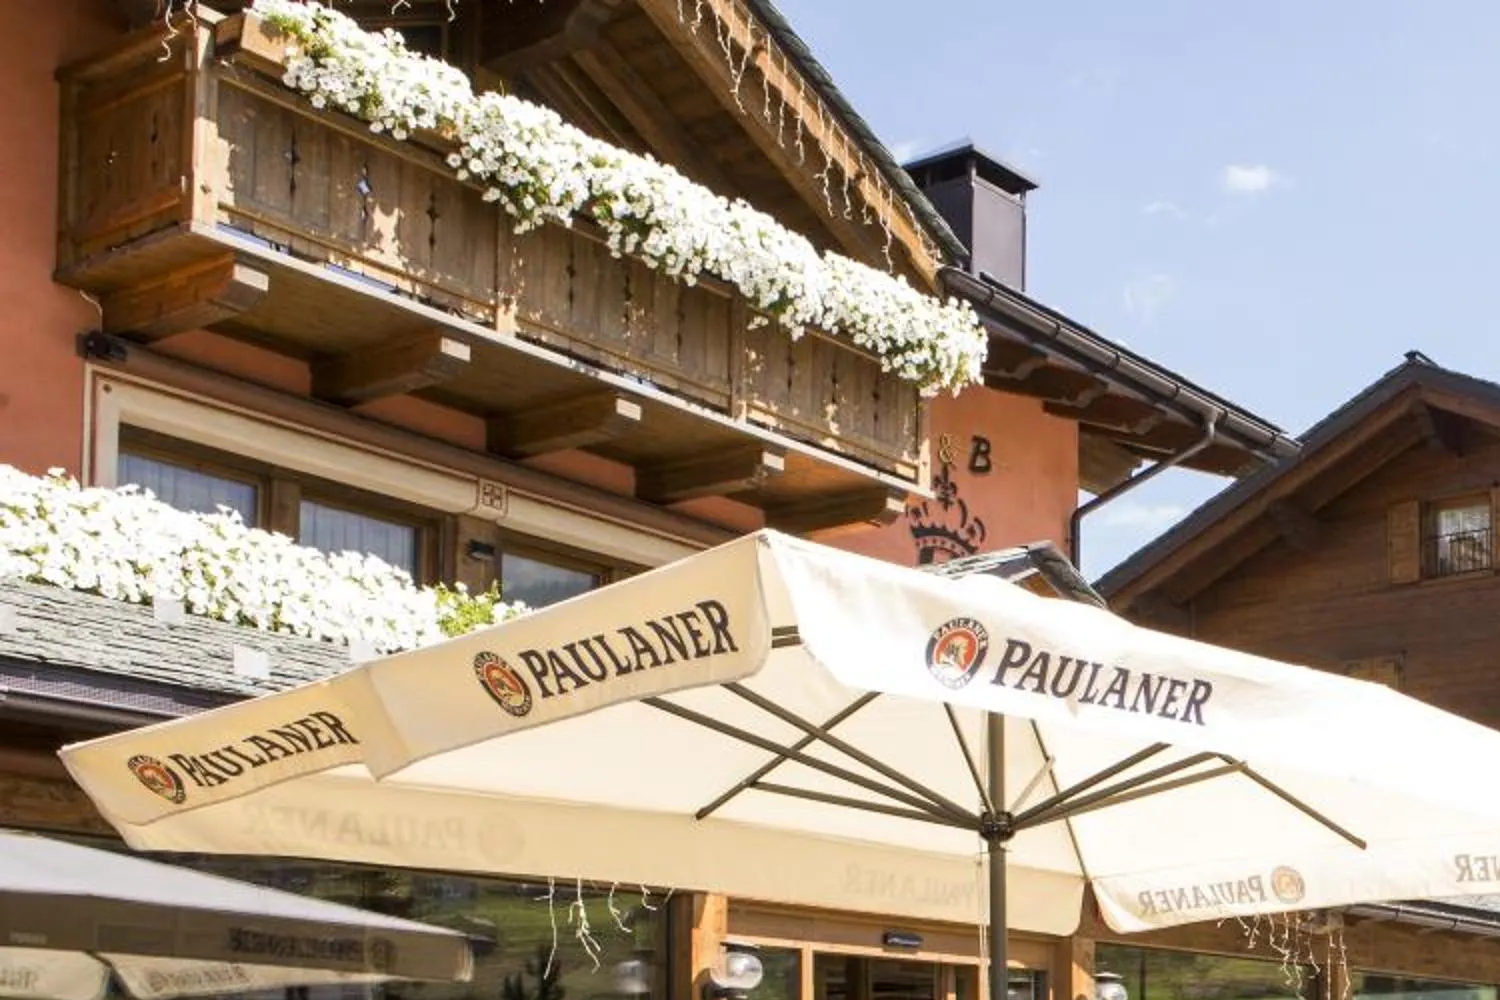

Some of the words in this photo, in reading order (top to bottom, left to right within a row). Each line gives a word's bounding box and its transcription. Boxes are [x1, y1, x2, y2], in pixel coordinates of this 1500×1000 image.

[968, 434, 992, 474] B
[518, 600, 739, 699] PAULANER
[990, 638, 1213, 726] PAULANER
[168, 711, 360, 788] PAULANER
